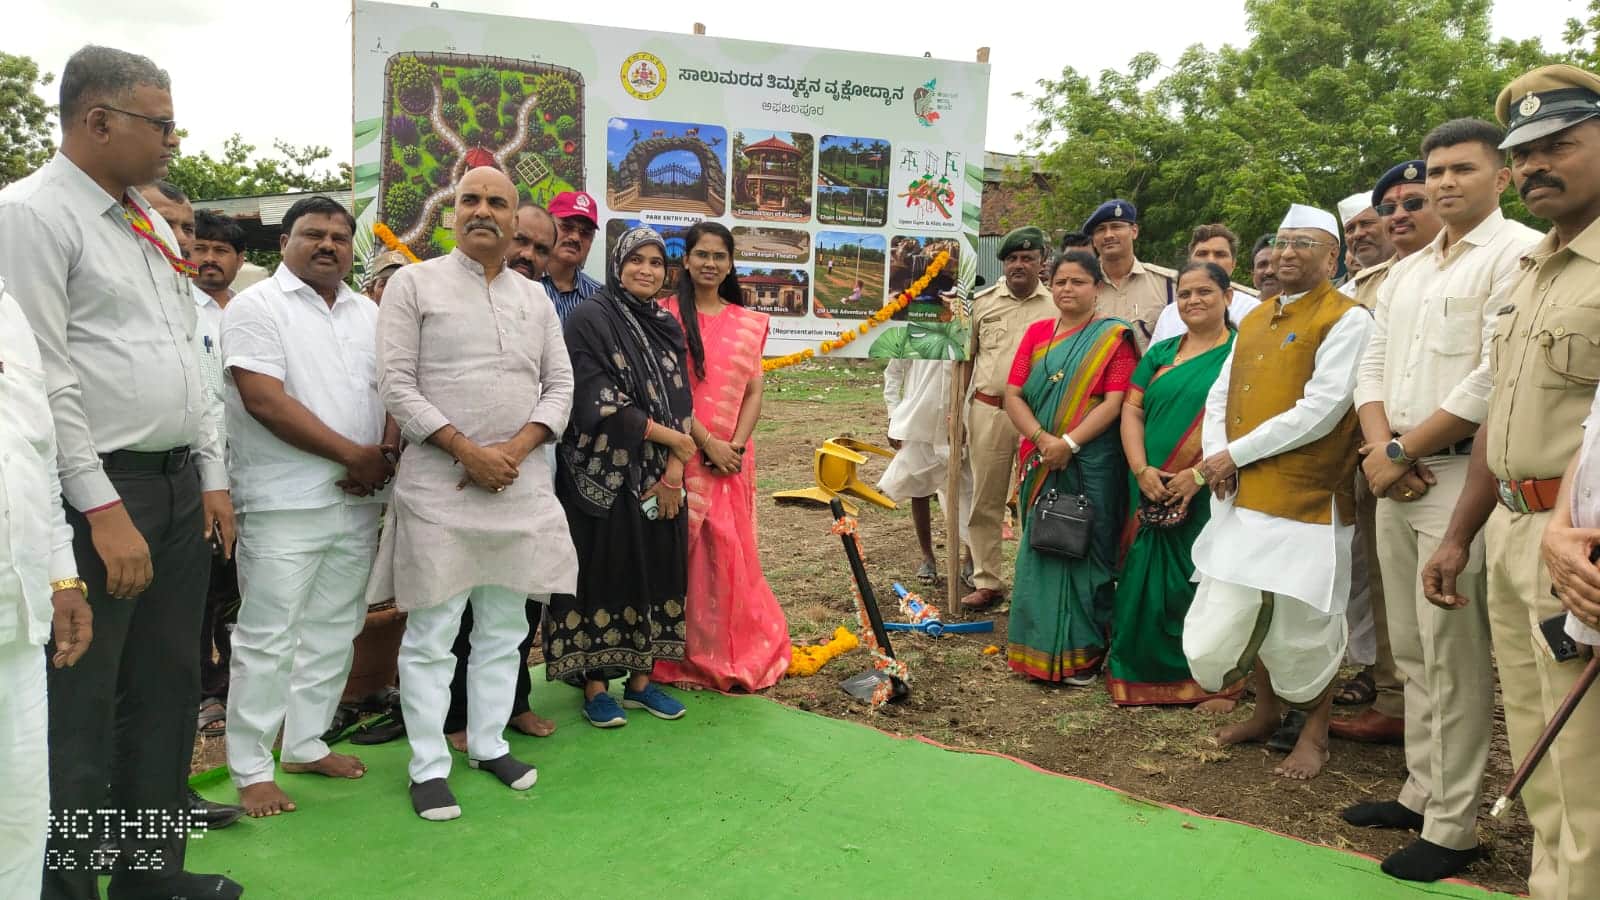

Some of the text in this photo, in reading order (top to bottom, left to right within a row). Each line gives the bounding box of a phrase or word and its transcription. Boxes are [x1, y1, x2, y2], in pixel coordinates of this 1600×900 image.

[737, 208, 773, 216] Construction
[741, 250, 756, 259] Open
[776, 252, 798, 260] Theatre
